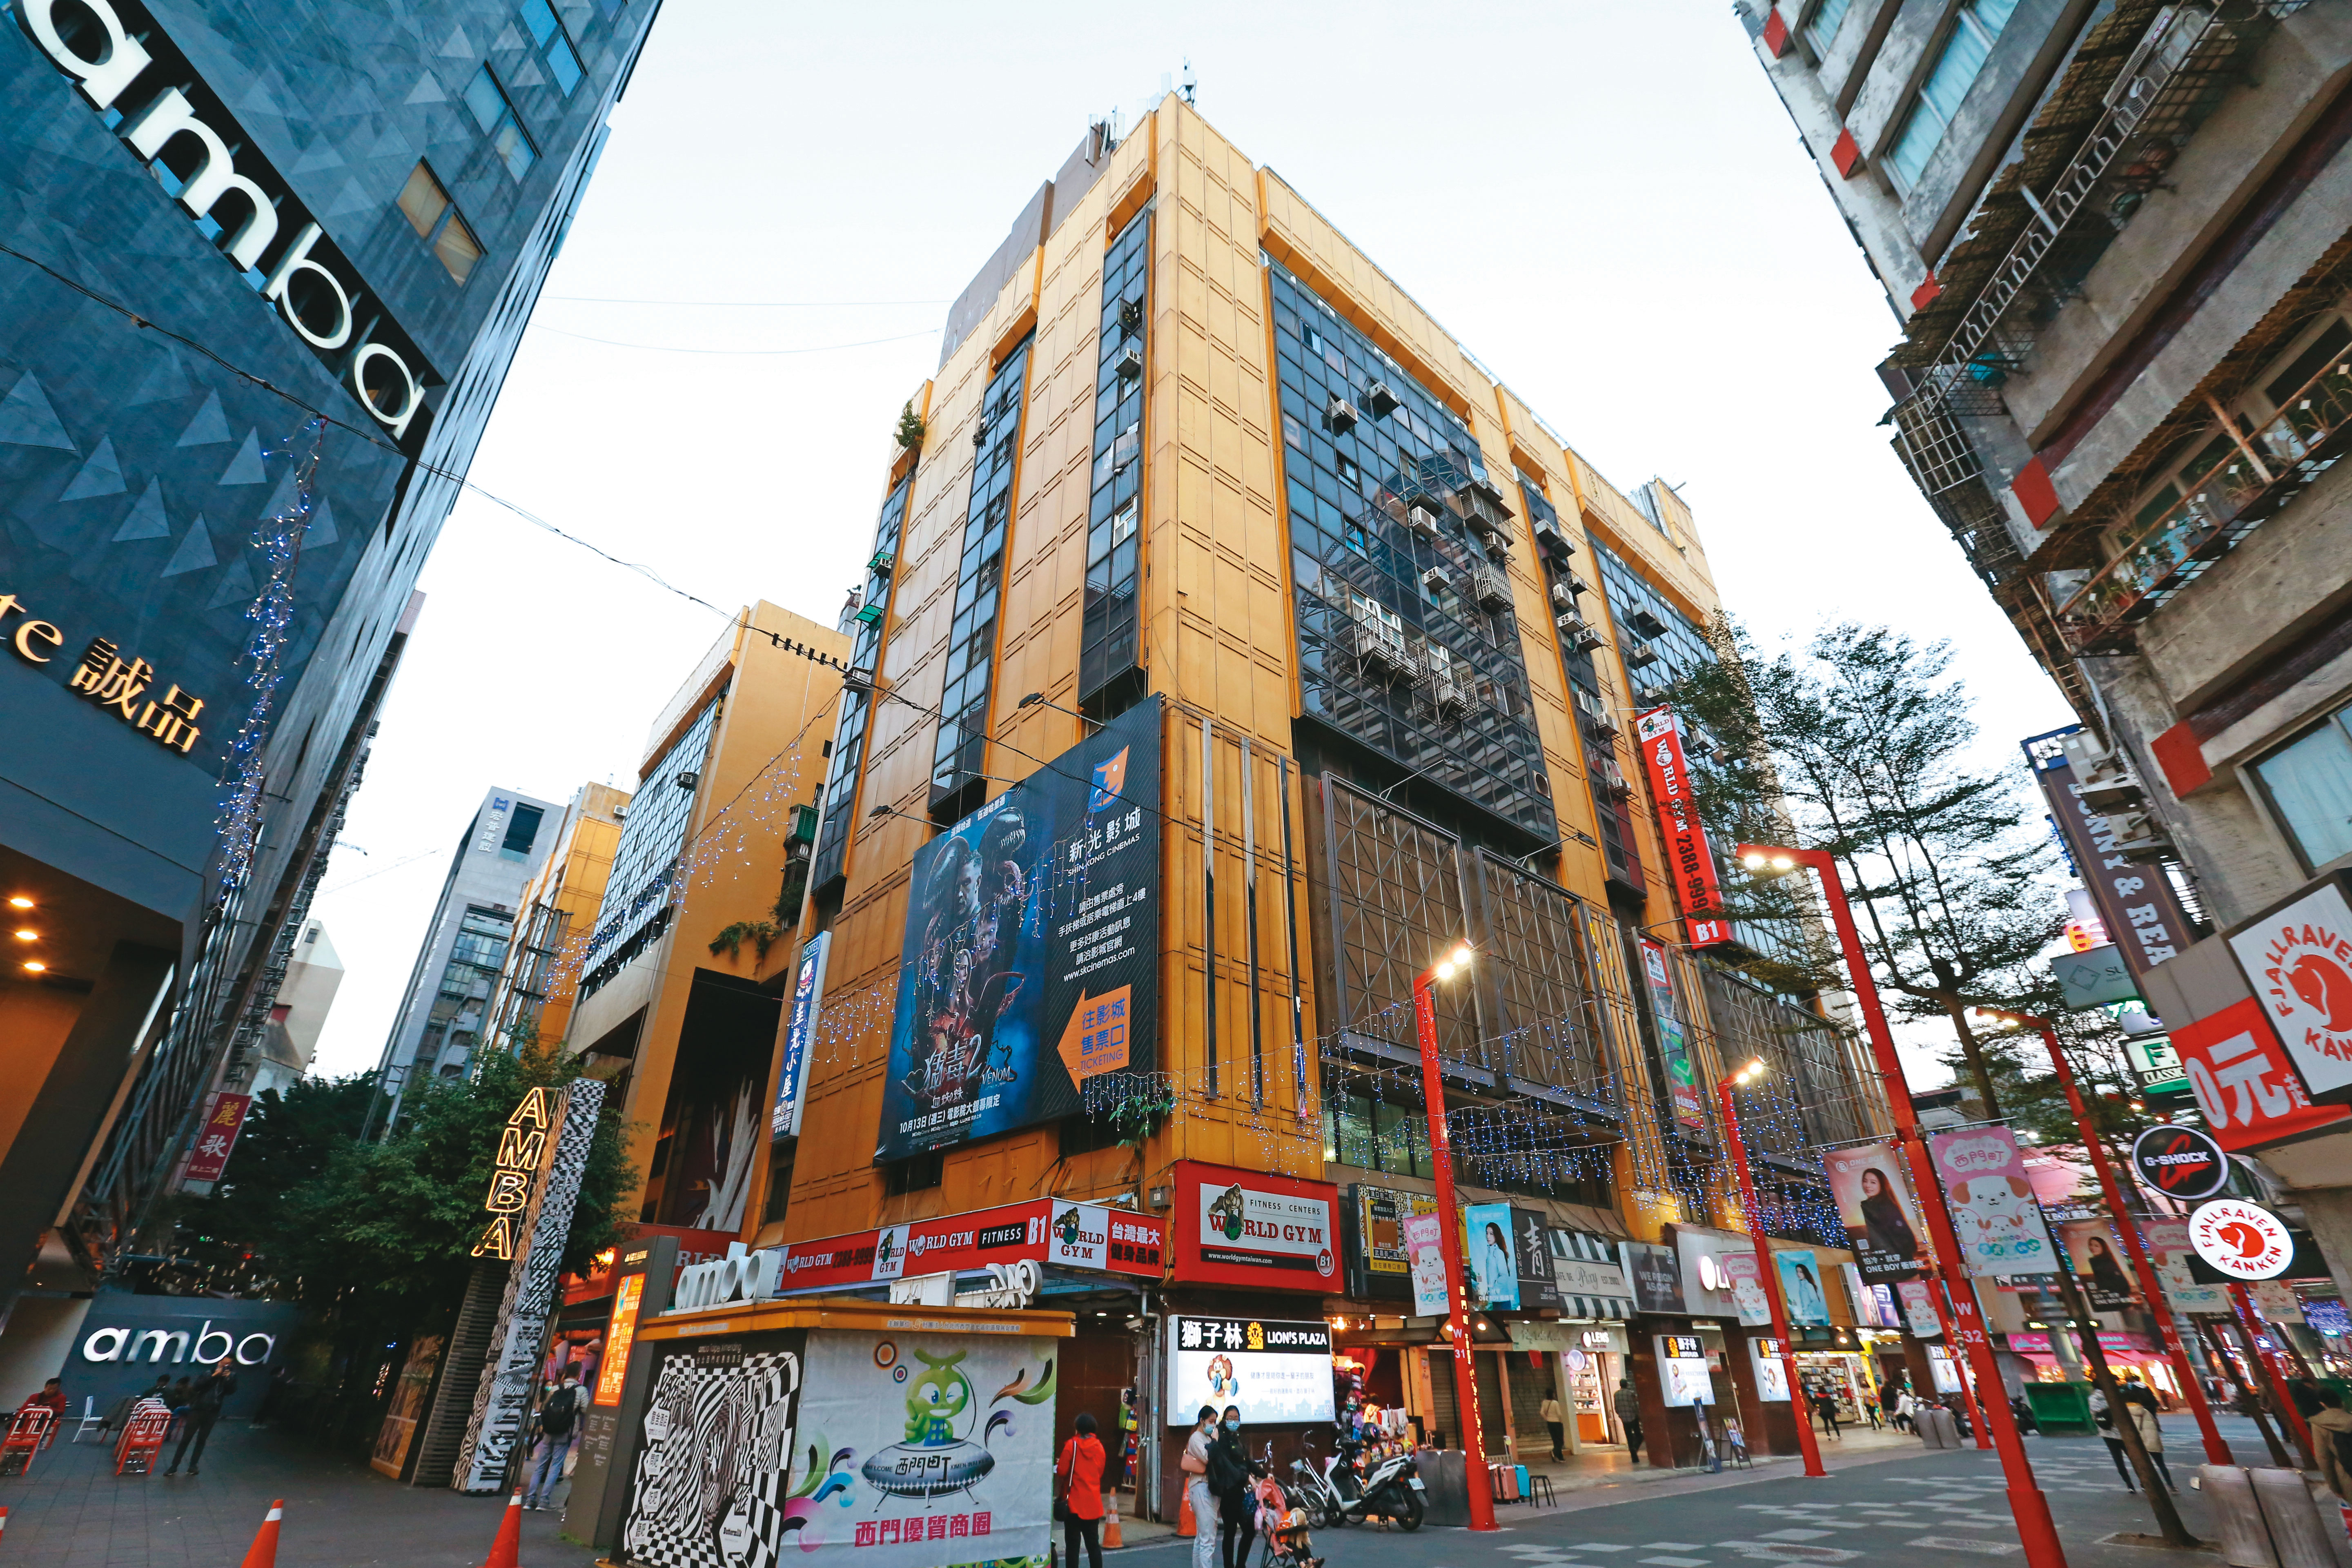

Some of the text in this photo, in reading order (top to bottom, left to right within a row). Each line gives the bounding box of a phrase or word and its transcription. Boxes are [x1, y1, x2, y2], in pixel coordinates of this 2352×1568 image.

[20, 0, 425, 439] amba
[71, 638, 204, 753] 誠品
[1069, 806, 1141, 863] 新光影城
[1067, 864, 1085, 877] SHIN
[1106, 833, 1140, 856] CINEMAS
[1675, 834, 1709, 911] 2388-999
[1078, 883, 1124, 914] 請由售票處旁
[1069, 916, 1131, 953] 更多好康活動訊息
[1696, 920, 1719, 942] B1
[803, 940, 818, 958] HOTEL
[1076, 935, 1123, 965] 請洽影城官網
[1063, 946, 1135, 982] www.skcinemas.com
[1082, 998, 1125, 1031] 往影城
[781, 1001, 804, 1098] 星光小屋
[1081, 1024, 1124, 1056] 售票口
[1080, 1049, 1123, 1071] TICKETING
[981, 1066, 1011, 1085] VENOM
[899, 1115, 927, 1134] 10月13日
[947, 1094, 1001, 1120] 電影院大銀幕限定
[2143, 1151, 2212, 1167] G-SHOCK
[470, 1087, 547, 1260] AMBA
[1250, 1199, 1321, 1215] FITNESS CENTERS
[948, 1230, 974, 1247] GYM
[982, 1227, 1022, 1245] FITNESS
[1027, 1215, 1047, 1245] B1
[1111, 1222, 1160, 1246] 台灣最大
[1283, 1225, 1323, 1244] GYM
[1413, 1227, 1439, 1240] 西門町
[815, 1253, 833, 1267] GYM
[1060, 1244, 1094, 1259] GYM
[1110, 1243, 1160, 1266] 健身品牌
[1208, 1252, 1272, 1264] www.worldgymtaiwan.com
[1513, 1229, 1523, 1276] DALONG
[1523, 1216, 1545, 1277] 青
[1541, 1233, 1552, 1278] TATTOO
[879, 1261, 898, 1273] GYM
[1319, 1255, 1331, 1267] B1
[1866, 1265, 1883, 1273] ONE
[675, 1241, 782, 1310] amba
[1954, 1302, 1972, 1316] W
[83, 1319, 277, 1365] amba
[1181, 1320, 1327, 1350] 獅子林 LION'S PLAZA
[1453, 1329, 1462, 1338] W
[1963, 1329, 1984, 1343] 32
[1454, 1349, 1466, 1359] 31
[865, 1463, 893, 1472] WELCOME
[895, 1455, 952, 1482] 西門町
[854, 1511, 991, 1548] 西門優質商圈
